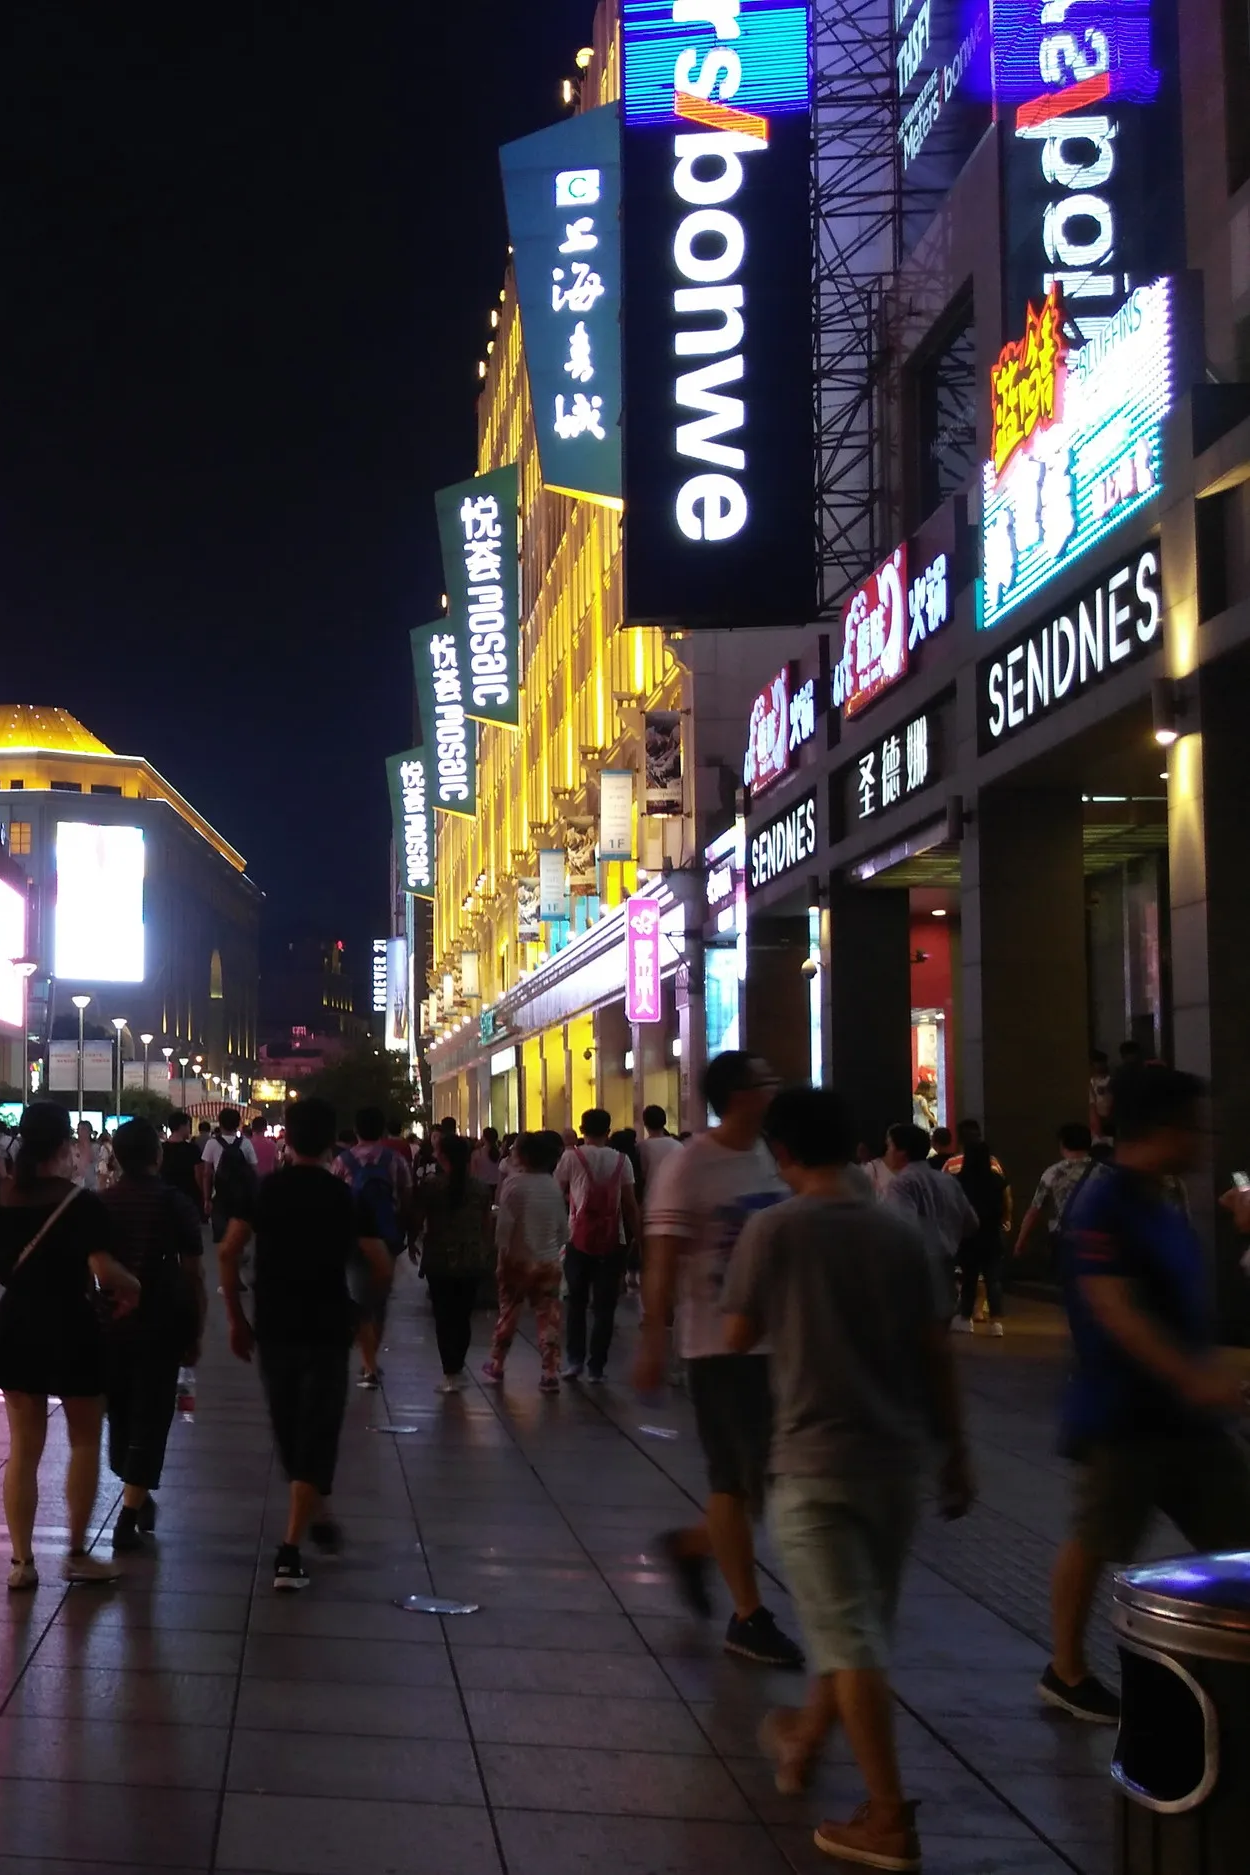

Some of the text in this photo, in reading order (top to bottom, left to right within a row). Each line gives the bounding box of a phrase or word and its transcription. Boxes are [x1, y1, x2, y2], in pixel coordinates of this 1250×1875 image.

[908, 553, 947, 651] 火锅
[987, 551, 1158, 738] SENDNES
[858, 715, 928, 819] 圣德娜
[609, 838, 626, 849] 1F
[751, 798, 816, 889] SENDNES
[373, 939, 387, 1012] FOREVER 21
